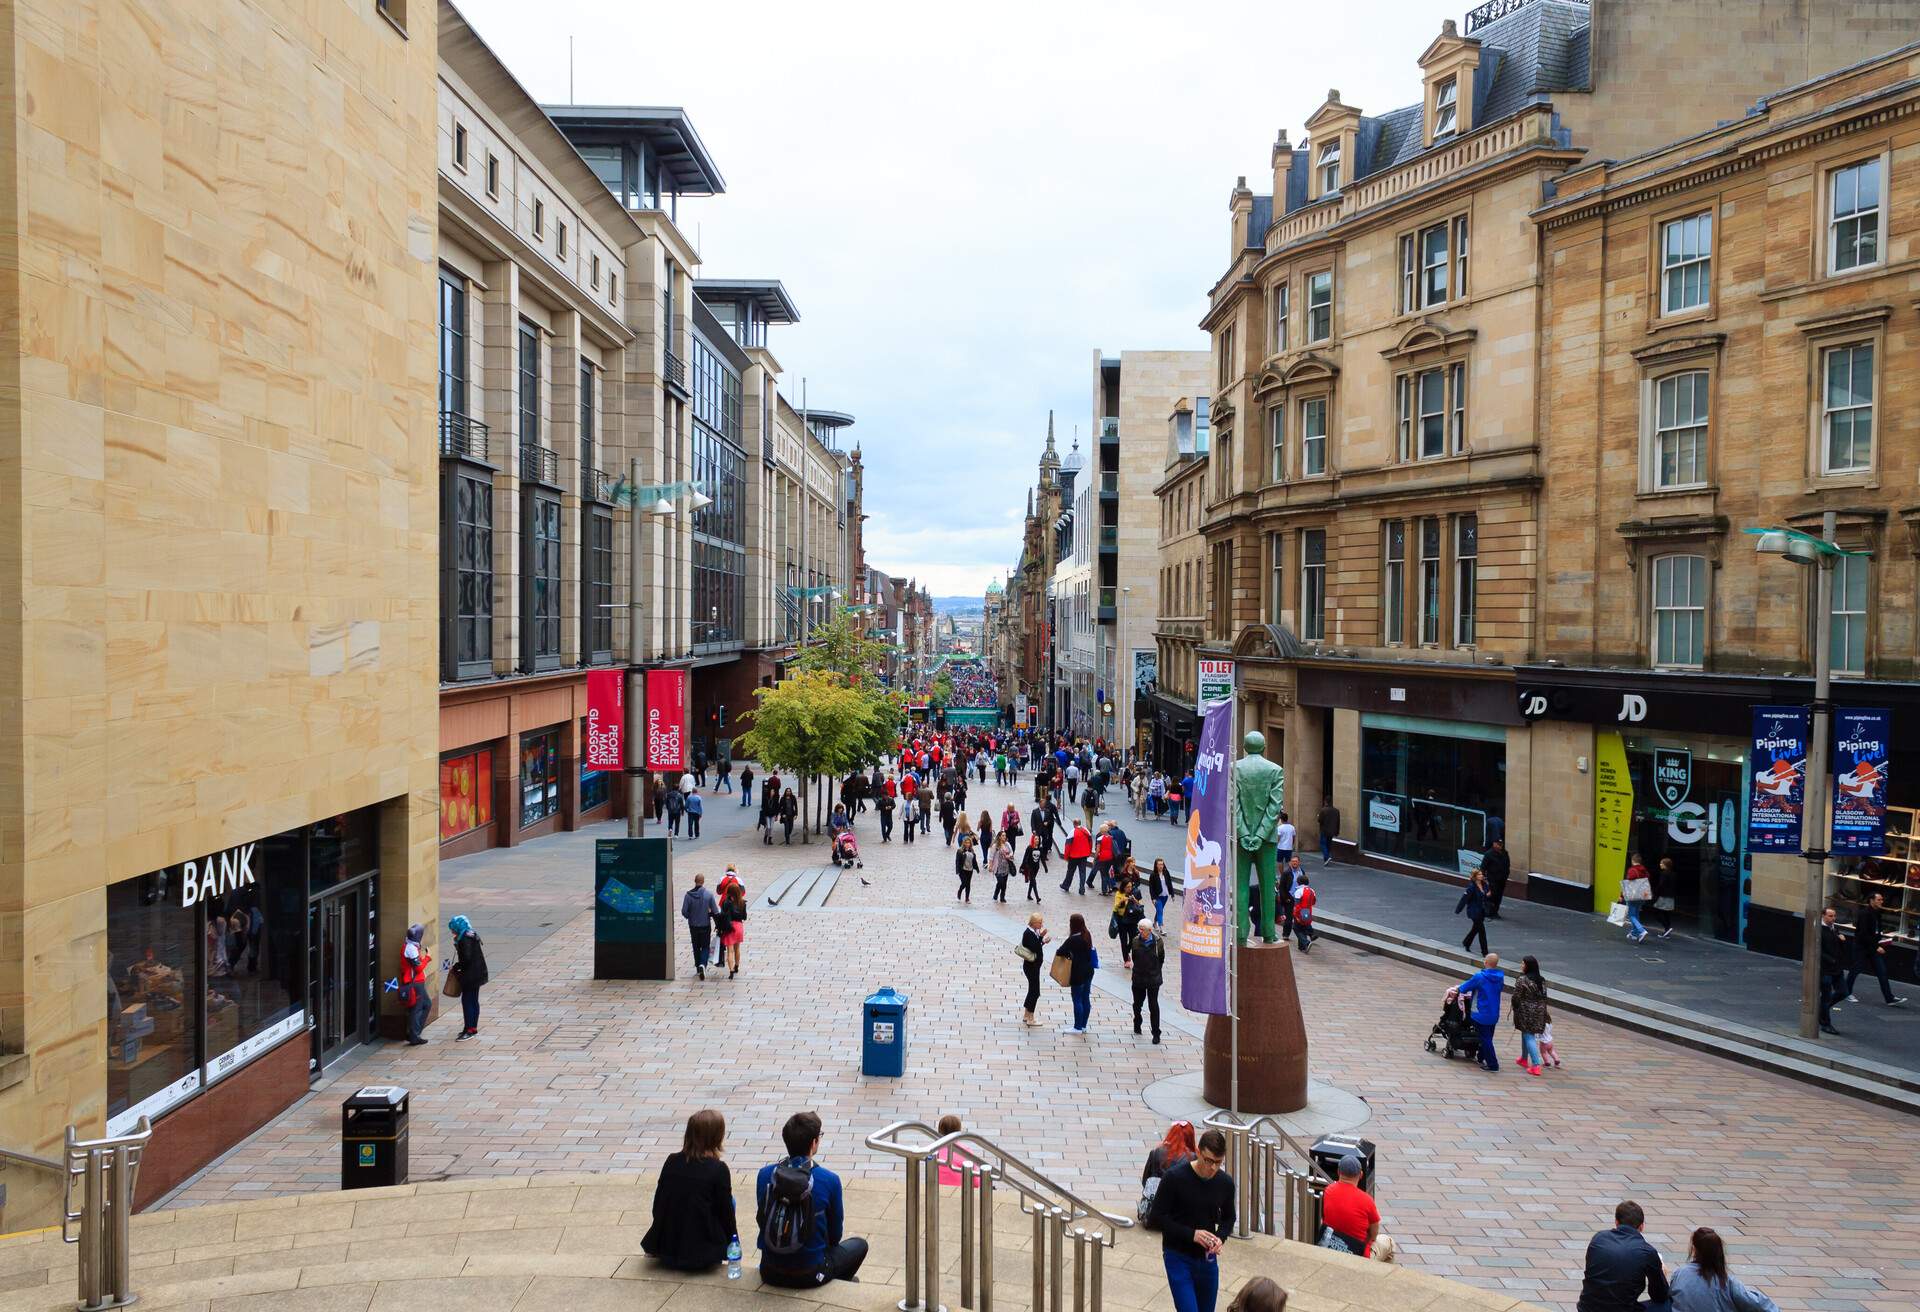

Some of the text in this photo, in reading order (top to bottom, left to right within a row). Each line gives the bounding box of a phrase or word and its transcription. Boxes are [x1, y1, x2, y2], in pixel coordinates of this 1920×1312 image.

[1200, 661, 1233, 673] TO LET
[1525, 696, 1548, 715] JD
[1617, 694, 1648, 722] JD
[589, 708, 599, 765] GLASGOW
[598, 733, 609, 765] MAKE
[608, 725, 618, 765] PEOPLE
[649, 708, 659, 765] GLASGOW
[659, 733, 669, 765] MAKE
[669, 725, 679, 765] PEOPLE
[1755, 737, 1797, 751] Piping
[1838, 739, 1879, 754] Piping
[1770, 741, 1803, 763] Live!
[1853, 743, 1885, 765] Live!
[1658, 766, 1687, 780] KING
[1372, 811, 1394, 822] Redpath
[182, 842, 256, 908] BANK
